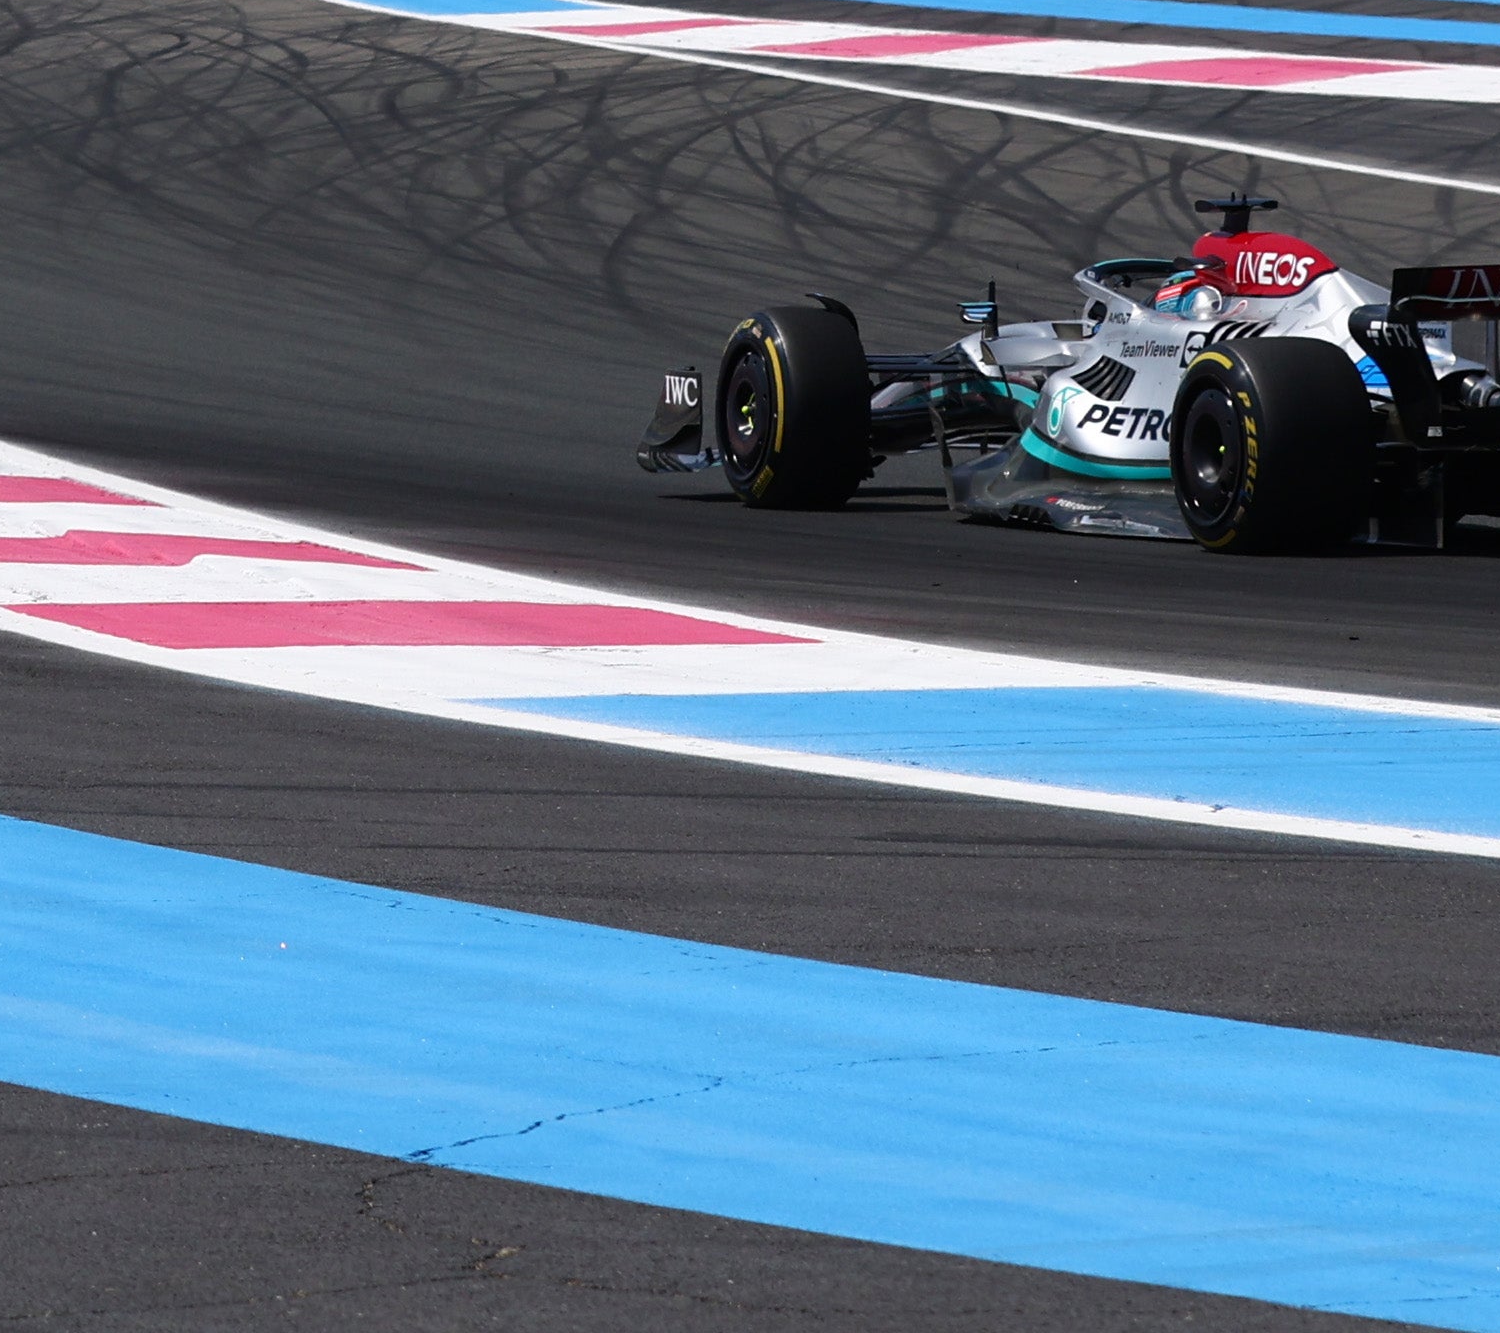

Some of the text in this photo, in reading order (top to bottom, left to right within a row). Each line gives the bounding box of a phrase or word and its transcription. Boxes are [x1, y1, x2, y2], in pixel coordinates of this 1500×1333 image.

[1235, 251, 1315, 287] INEOS
[1119, 340, 1180, 358] TeamViewer
[1382, 321, 1418, 348] FTX
[665, 375, 698, 407] IWC
